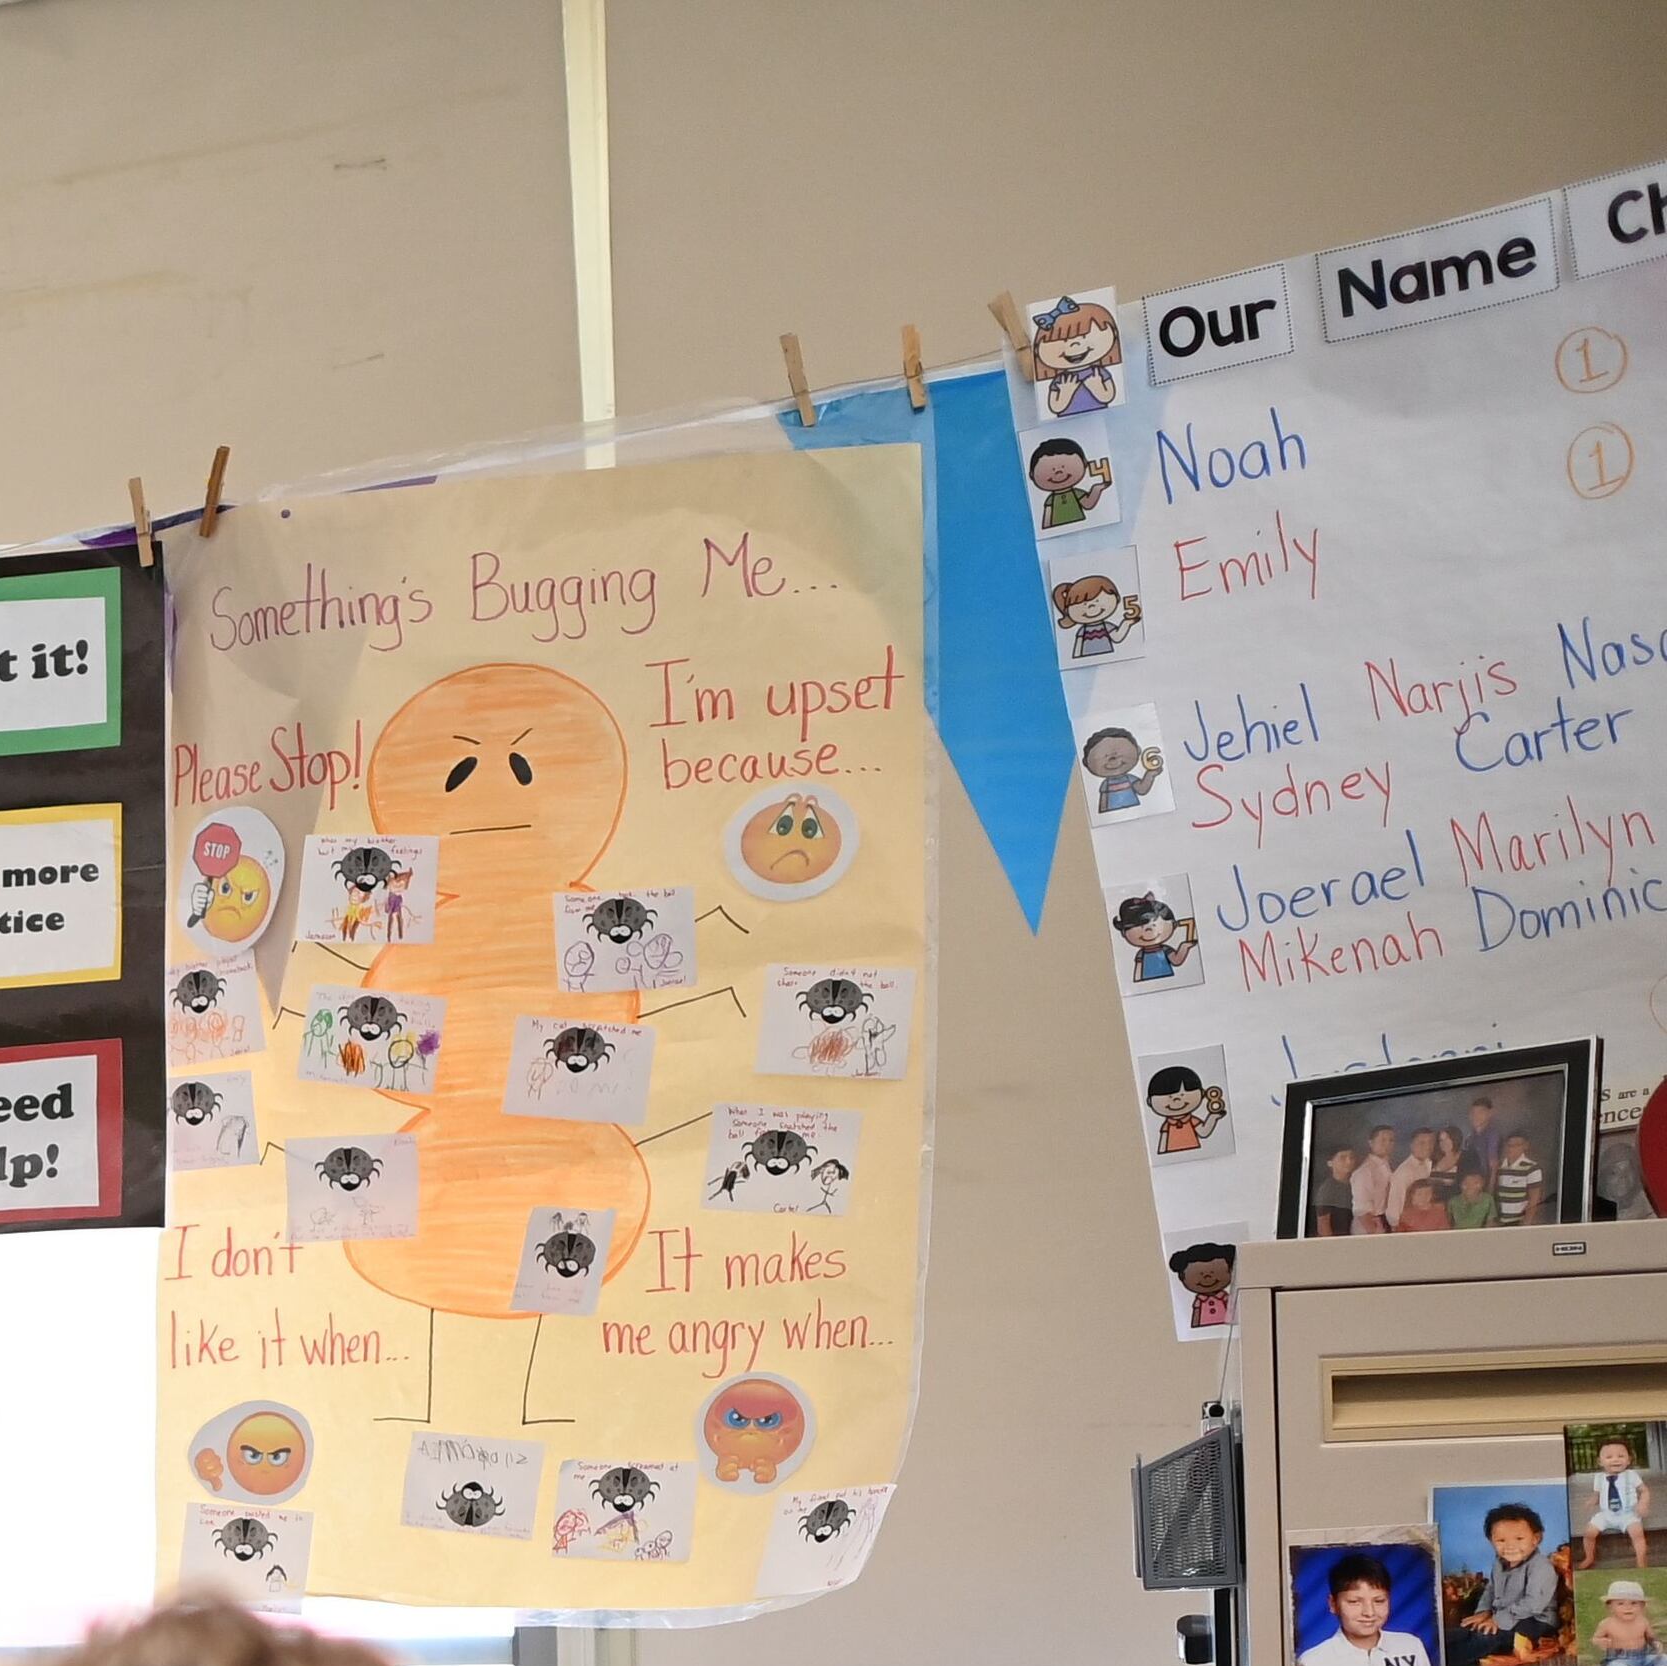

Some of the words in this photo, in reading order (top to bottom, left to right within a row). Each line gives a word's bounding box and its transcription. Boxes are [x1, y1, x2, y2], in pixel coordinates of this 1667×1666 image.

[1158, 295, 1277, 358] Our
[1337, 235, 1537, 318] Name
[1156, 407, 1307, 505] Noah
[209, 563, 433, 652] Something's
[469, 551, 659, 642] Bugging
[699, 531, 839, 601] Me...
[1173, 510, 1320, 601] Emily
[1123, 596, 1141, 628] 5
[31, 639, 89, 680] it!
[645, 658, 735, 729] I'm
[766, 644, 905, 743] upset
[1184, 682, 1320, 764] Jehiel
[1364, 654, 1518, 736] Narjis
[172, 742, 262, 808] Please
[268, 720, 363, 811] Stop!
[661, 739, 882, 792] because...
[1141, 748, 1164, 771] 6
[1191, 761, 1392, 850] Sydney
[1454, 696, 1635, 772] Carter
[2, 862, 100, 888] more
[203, 841, 231, 859] STOP
[1216, 828, 1425, 932] Joerael
[1450, 795, 1656, 889] Marilyn
[1239, 911, 1445, 993] Mikenah
[1472, 868, 1667, 953] Dominic
[164, 1223, 199, 1282] I
[212, 1225, 305, 1279] don't
[645, 1228, 703, 1296] It
[724, 1230, 847, 1290] makes
[169, 1311, 240, 1368] like
[257, 1307, 288, 1370] it
[300, 1313, 412, 1367] when...
[602, 1319, 655, 1357] me
[668, 1315, 766, 1380] angry
[783, 1298, 896, 1352] when...
